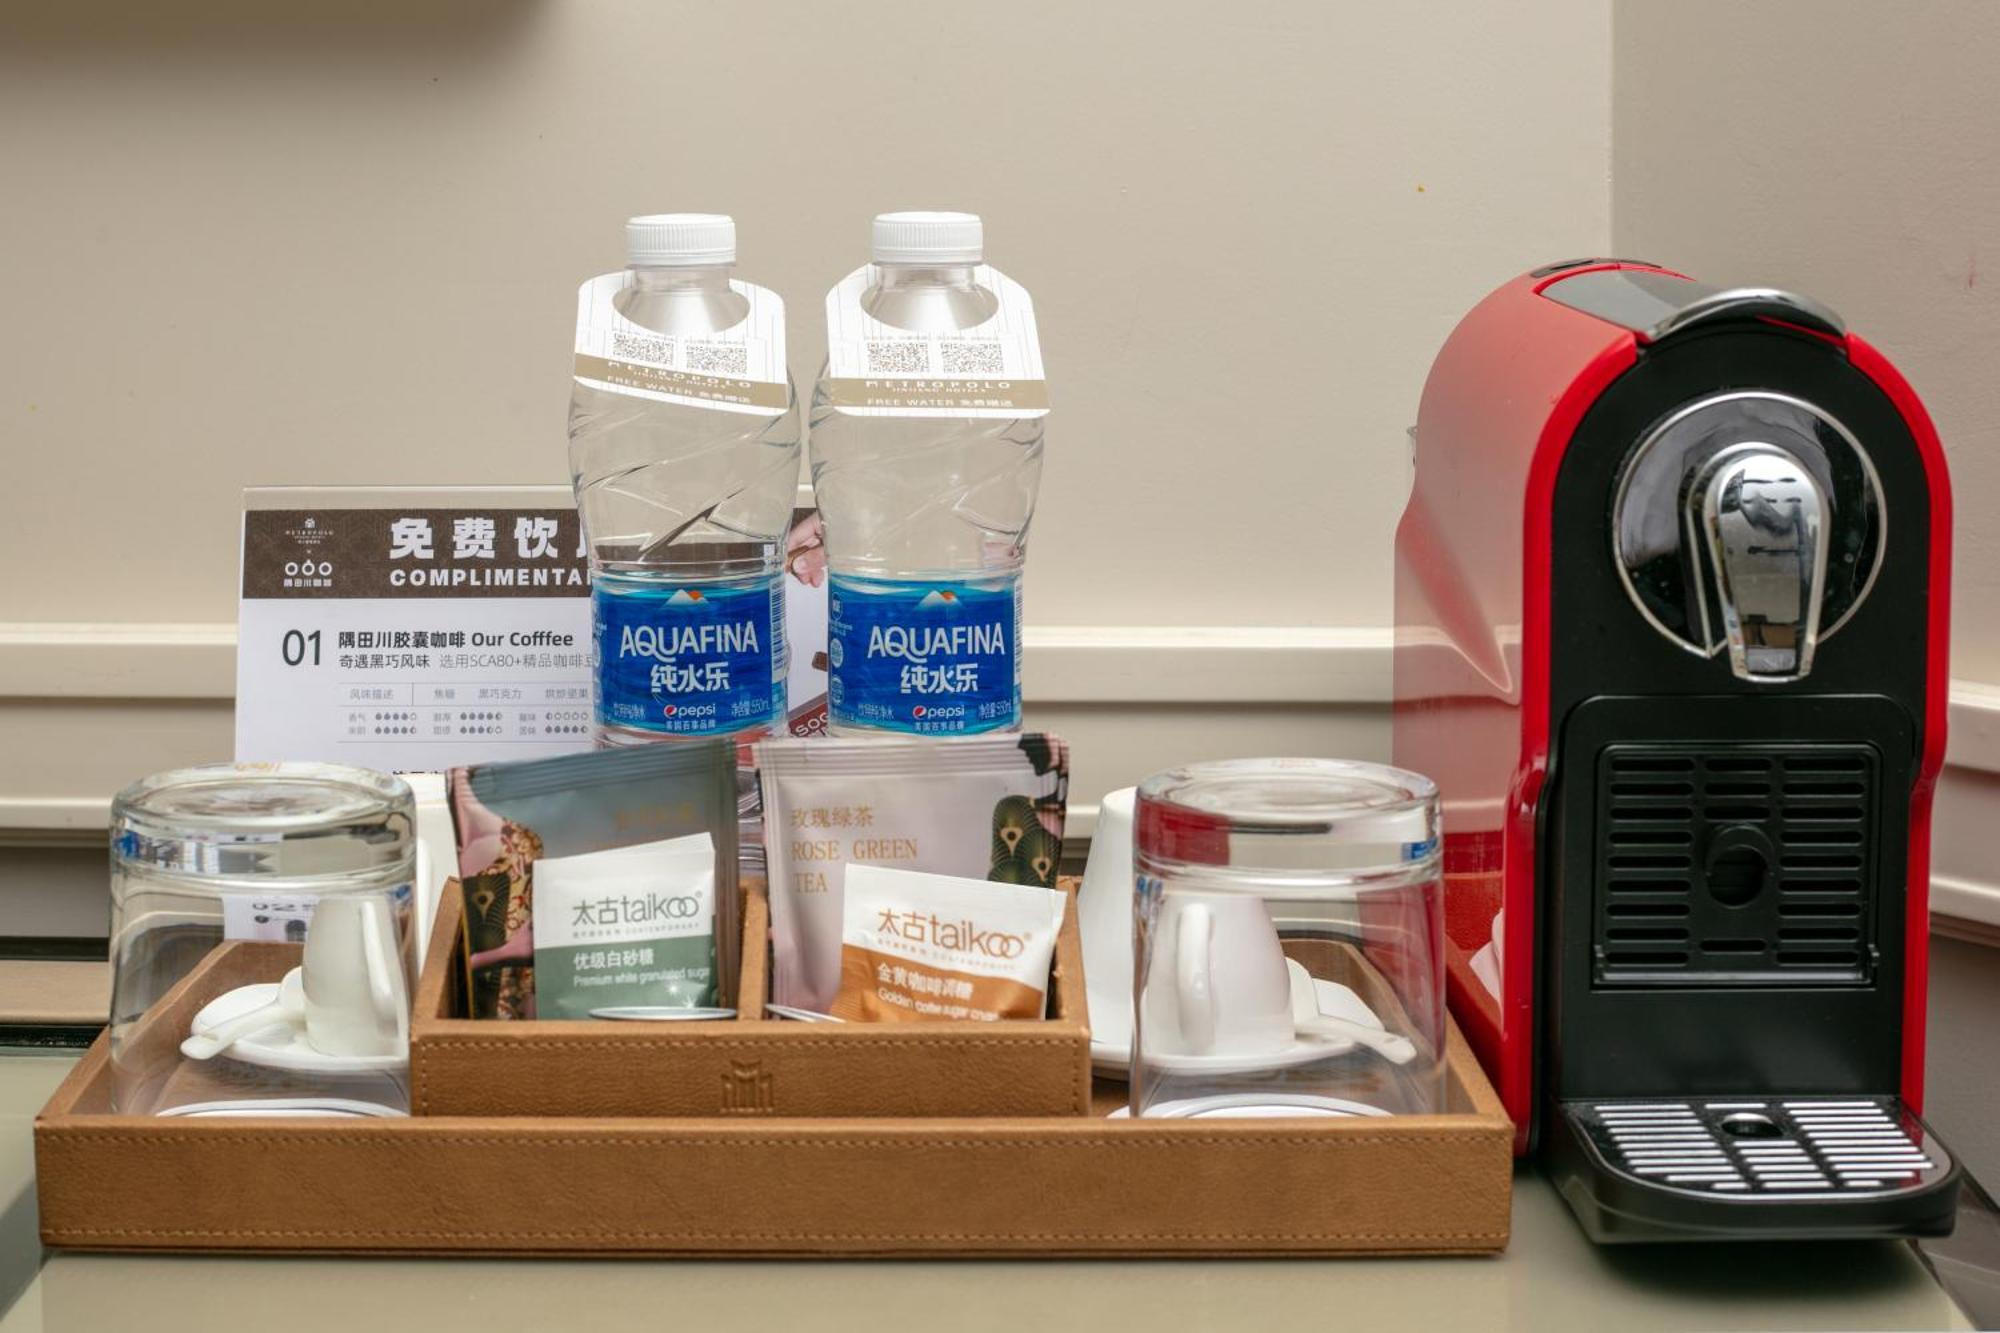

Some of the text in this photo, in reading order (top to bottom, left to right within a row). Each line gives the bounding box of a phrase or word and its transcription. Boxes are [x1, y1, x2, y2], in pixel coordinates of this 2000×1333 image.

[607, 375, 640, 387] FREE
[645, 382, 693, 396] WATER
[865, 380, 1011, 389] METROPOLO
[867, 398, 900, 406] FREE
[906, 399, 955, 407] WATER
[390, 517, 587, 559] 免费饮
[282, 629, 321, 666] 01
[339, 631, 467, 649] 隅田川胶囊咖啡
[471, 632, 504, 647] Our
[619, 620, 760, 663] AQUAFINA
[867, 621, 1006, 664] AQUAFINA
[339, 653, 431, 669] 奇遇黑巧风味
[650, 661, 731, 693] 纯水乐
[900, 662, 979, 694] 纯水乐
[678, 703, 716, 719] pepsi
[927, 704, 965, 720] pepsi
[790, 804, 874, 829] 玫瑰绿茶
[791, 837, 919, 861] ROSE GREEN
[791, 871, 829, 894] TEA
[573, 947, 655, 971] 优级白砂糖
